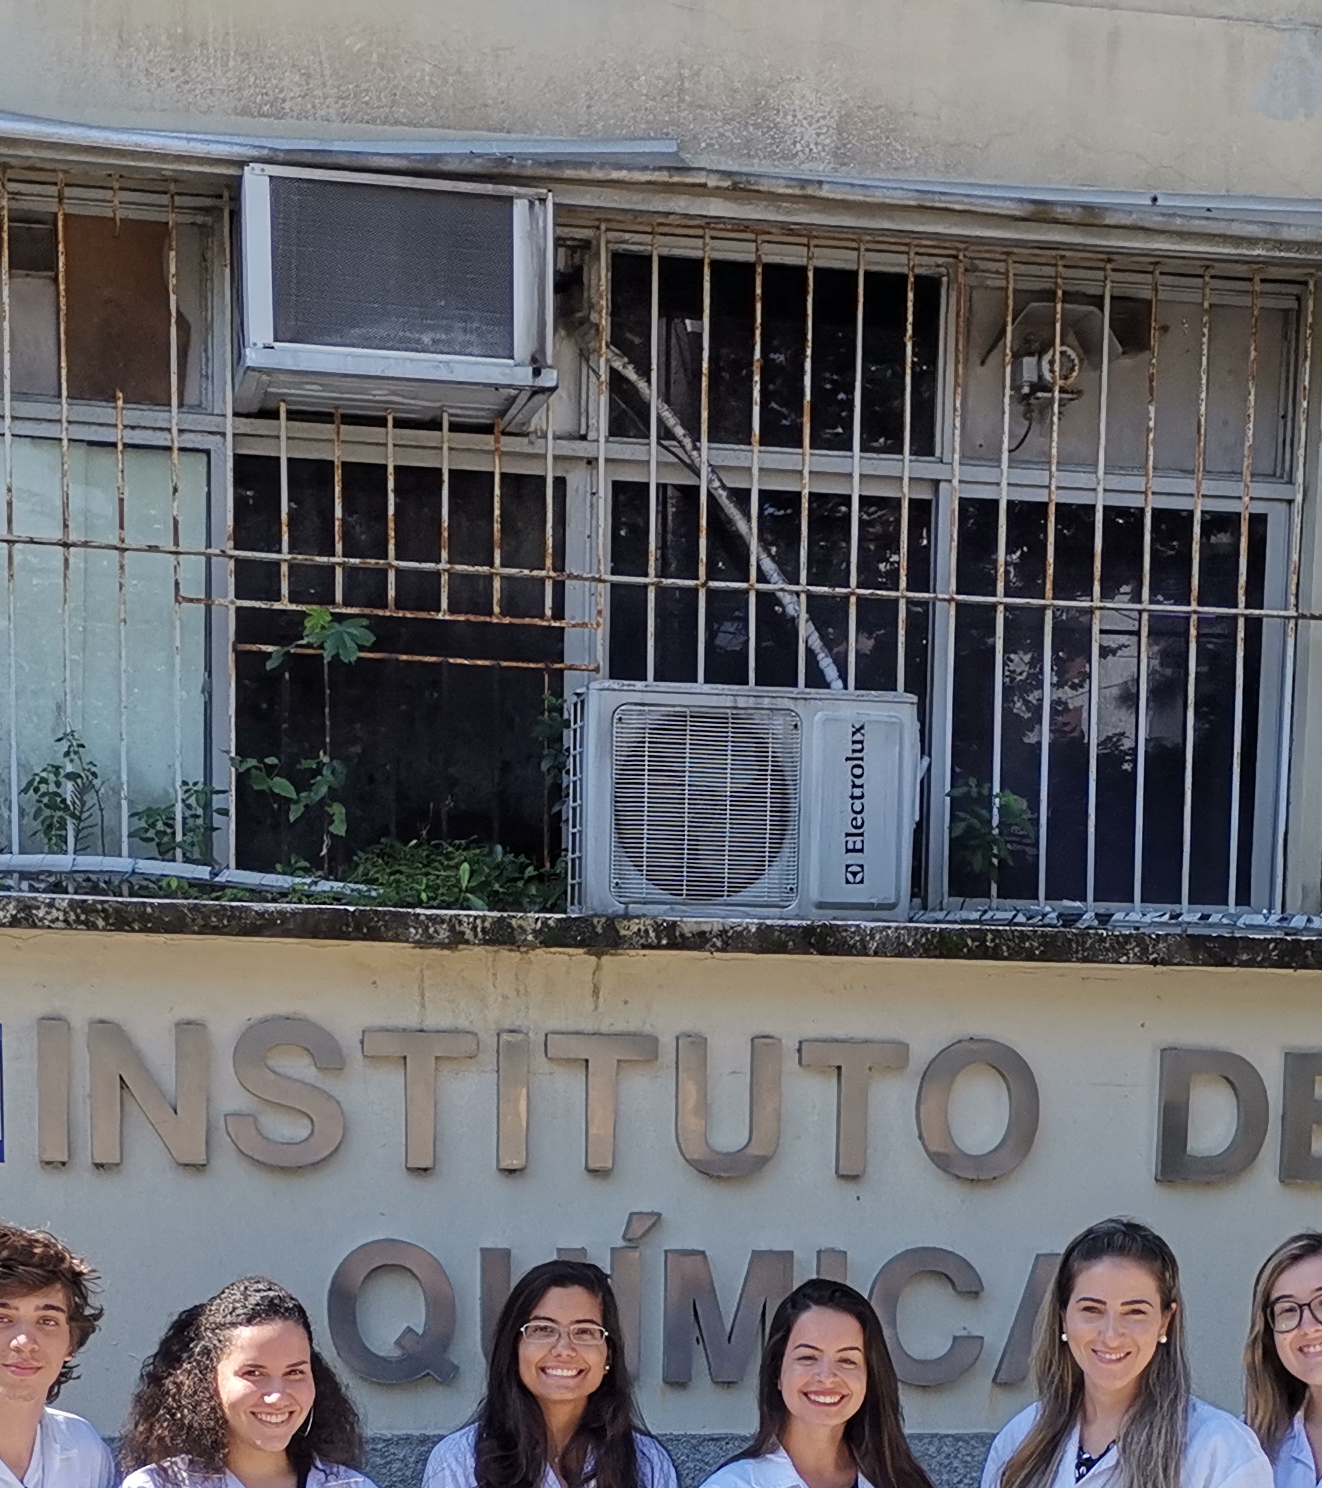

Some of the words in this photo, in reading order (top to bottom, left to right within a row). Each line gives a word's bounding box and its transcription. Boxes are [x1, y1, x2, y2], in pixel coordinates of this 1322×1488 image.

[844, 722, 866, 855] Electrolux
[37, 1014, 1041, 1181] INSTITUTO
[327, 1211, 1063, 1388] QÍMC
